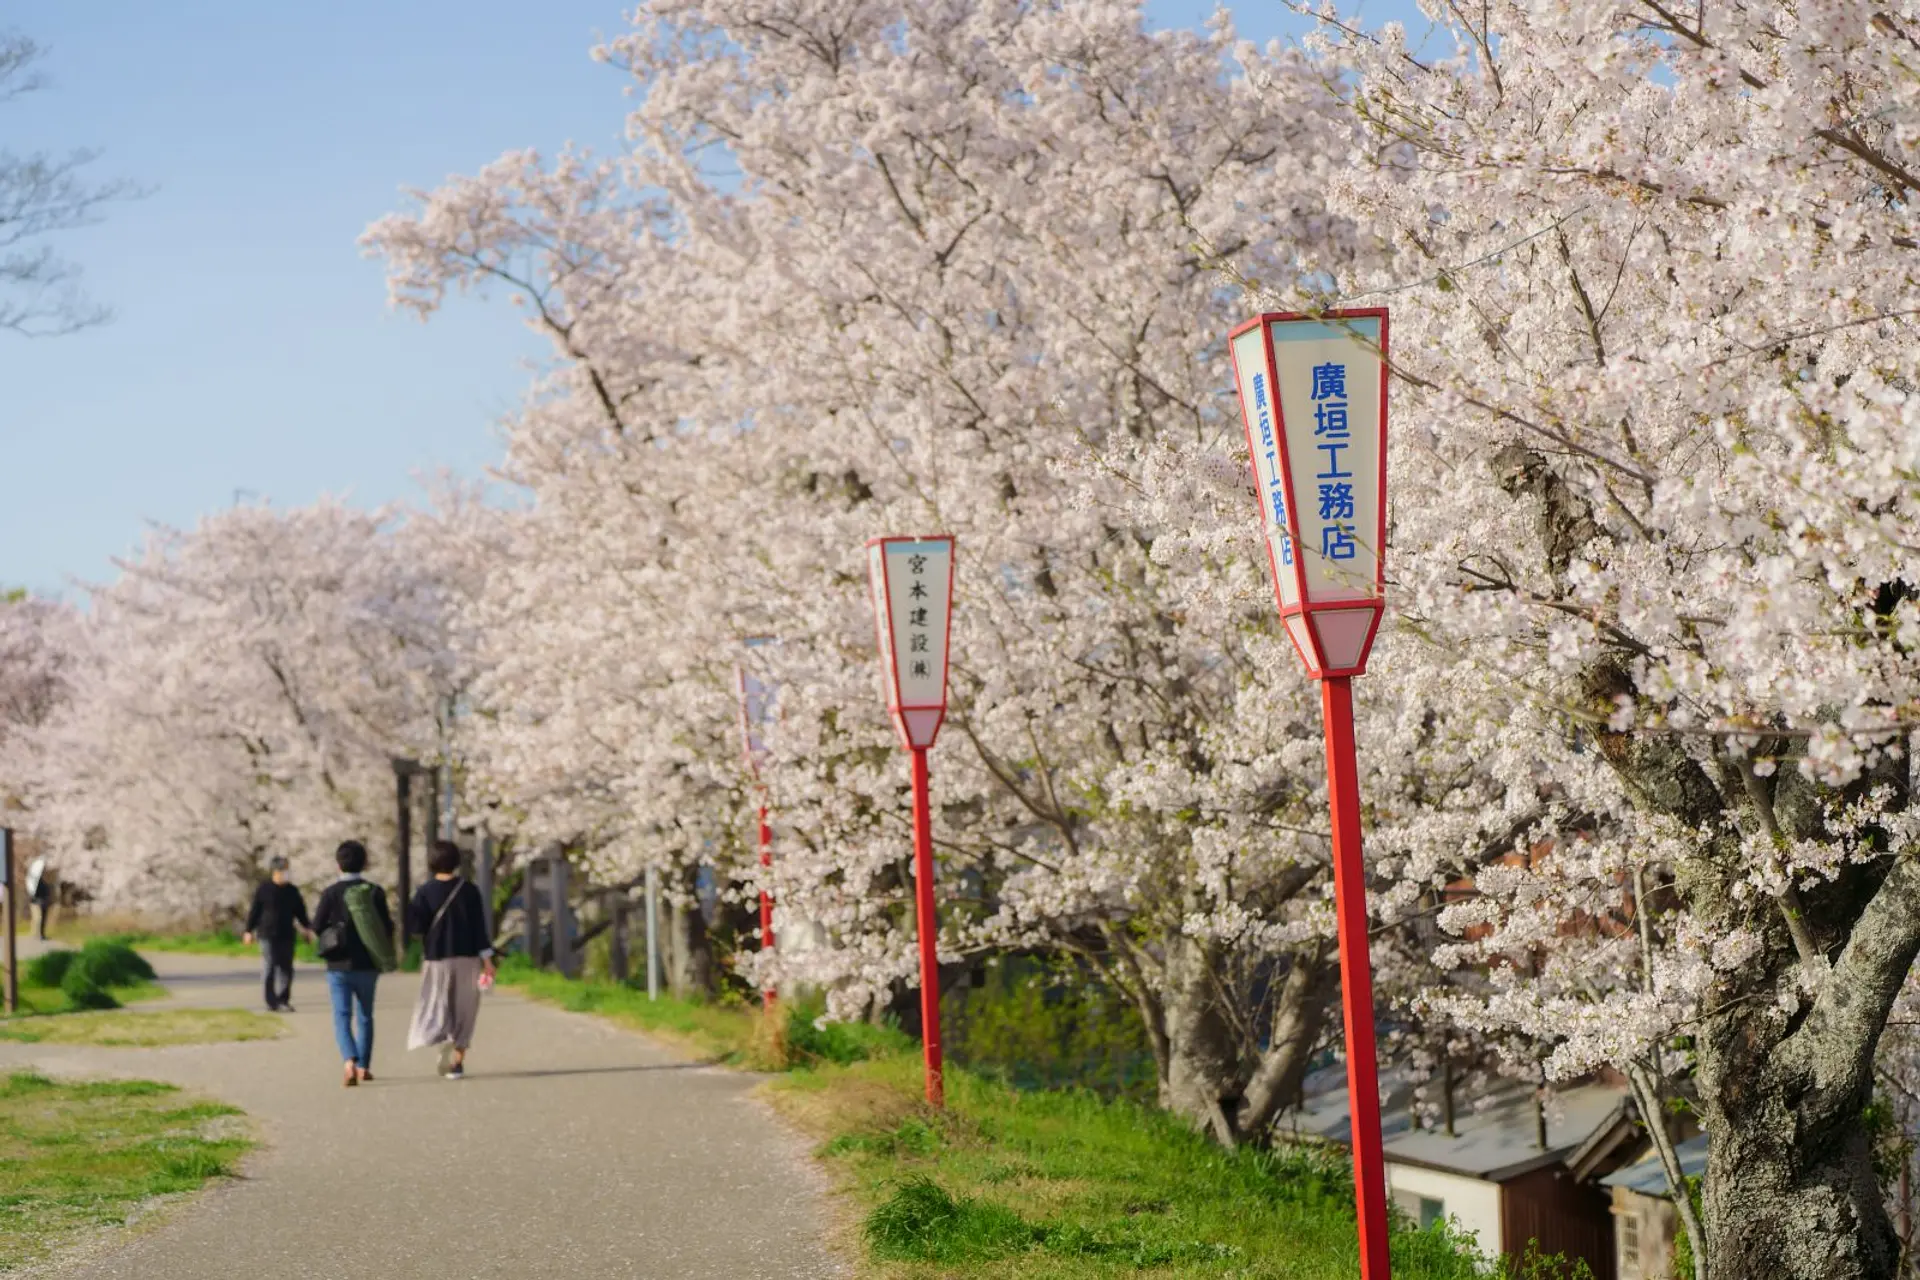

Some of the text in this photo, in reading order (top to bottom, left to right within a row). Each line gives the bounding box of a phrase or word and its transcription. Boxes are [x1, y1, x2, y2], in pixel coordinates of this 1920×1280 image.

[1310, 362, 1355, 560] 廣垣工務店
